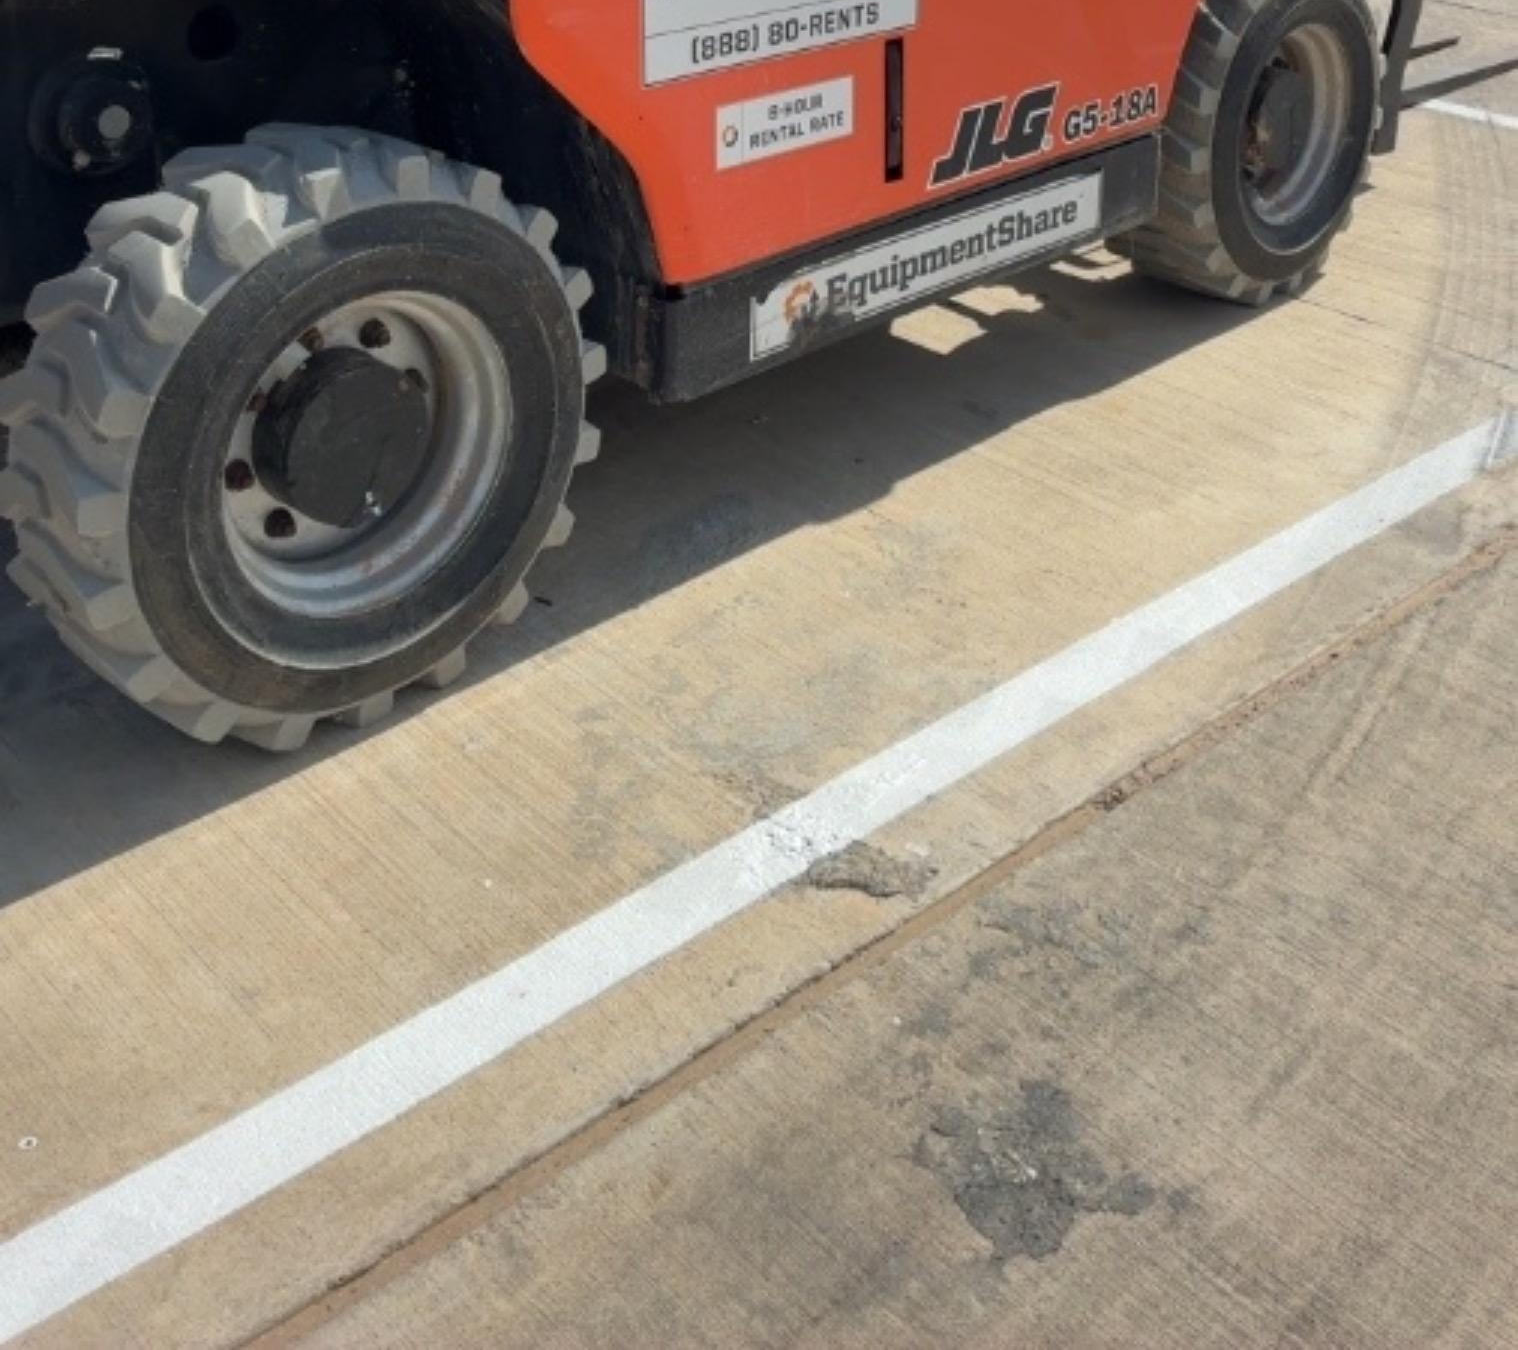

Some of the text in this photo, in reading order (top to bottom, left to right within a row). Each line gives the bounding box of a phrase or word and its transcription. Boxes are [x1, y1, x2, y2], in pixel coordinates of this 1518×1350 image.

[692, 2, 880, 63] (888) 80-RENTS
[750, 110, 845, 149] RENTAL RATE
[928, 83, 1158, 188] JLG G5-18A
[826, 199, 1078, 307] EquipmentShare
